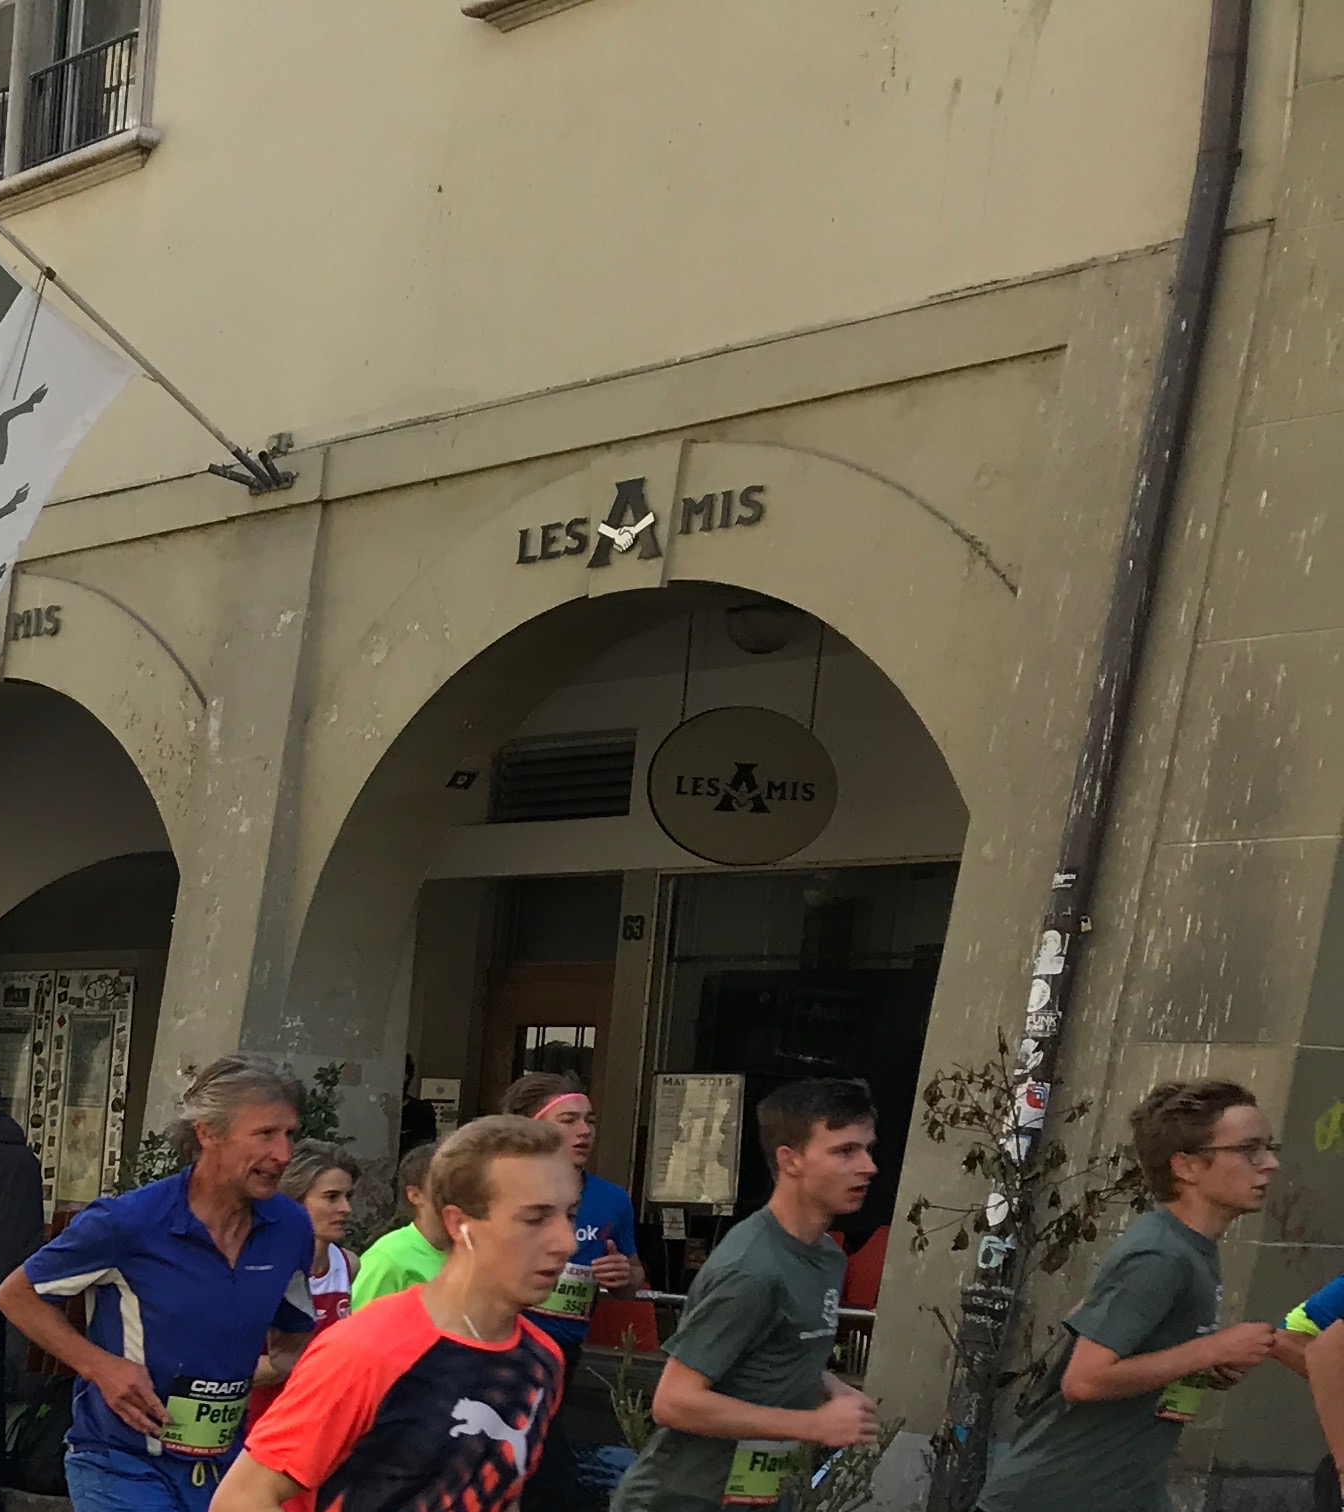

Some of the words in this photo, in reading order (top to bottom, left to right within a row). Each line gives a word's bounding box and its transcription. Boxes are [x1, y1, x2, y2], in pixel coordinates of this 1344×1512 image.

[516, 517, 589, 564] LES
[675, 776, 720, 797] LES
[575, 1225, 599, 1242] ok
[190, 1379, 245, 1395] CRAFT
